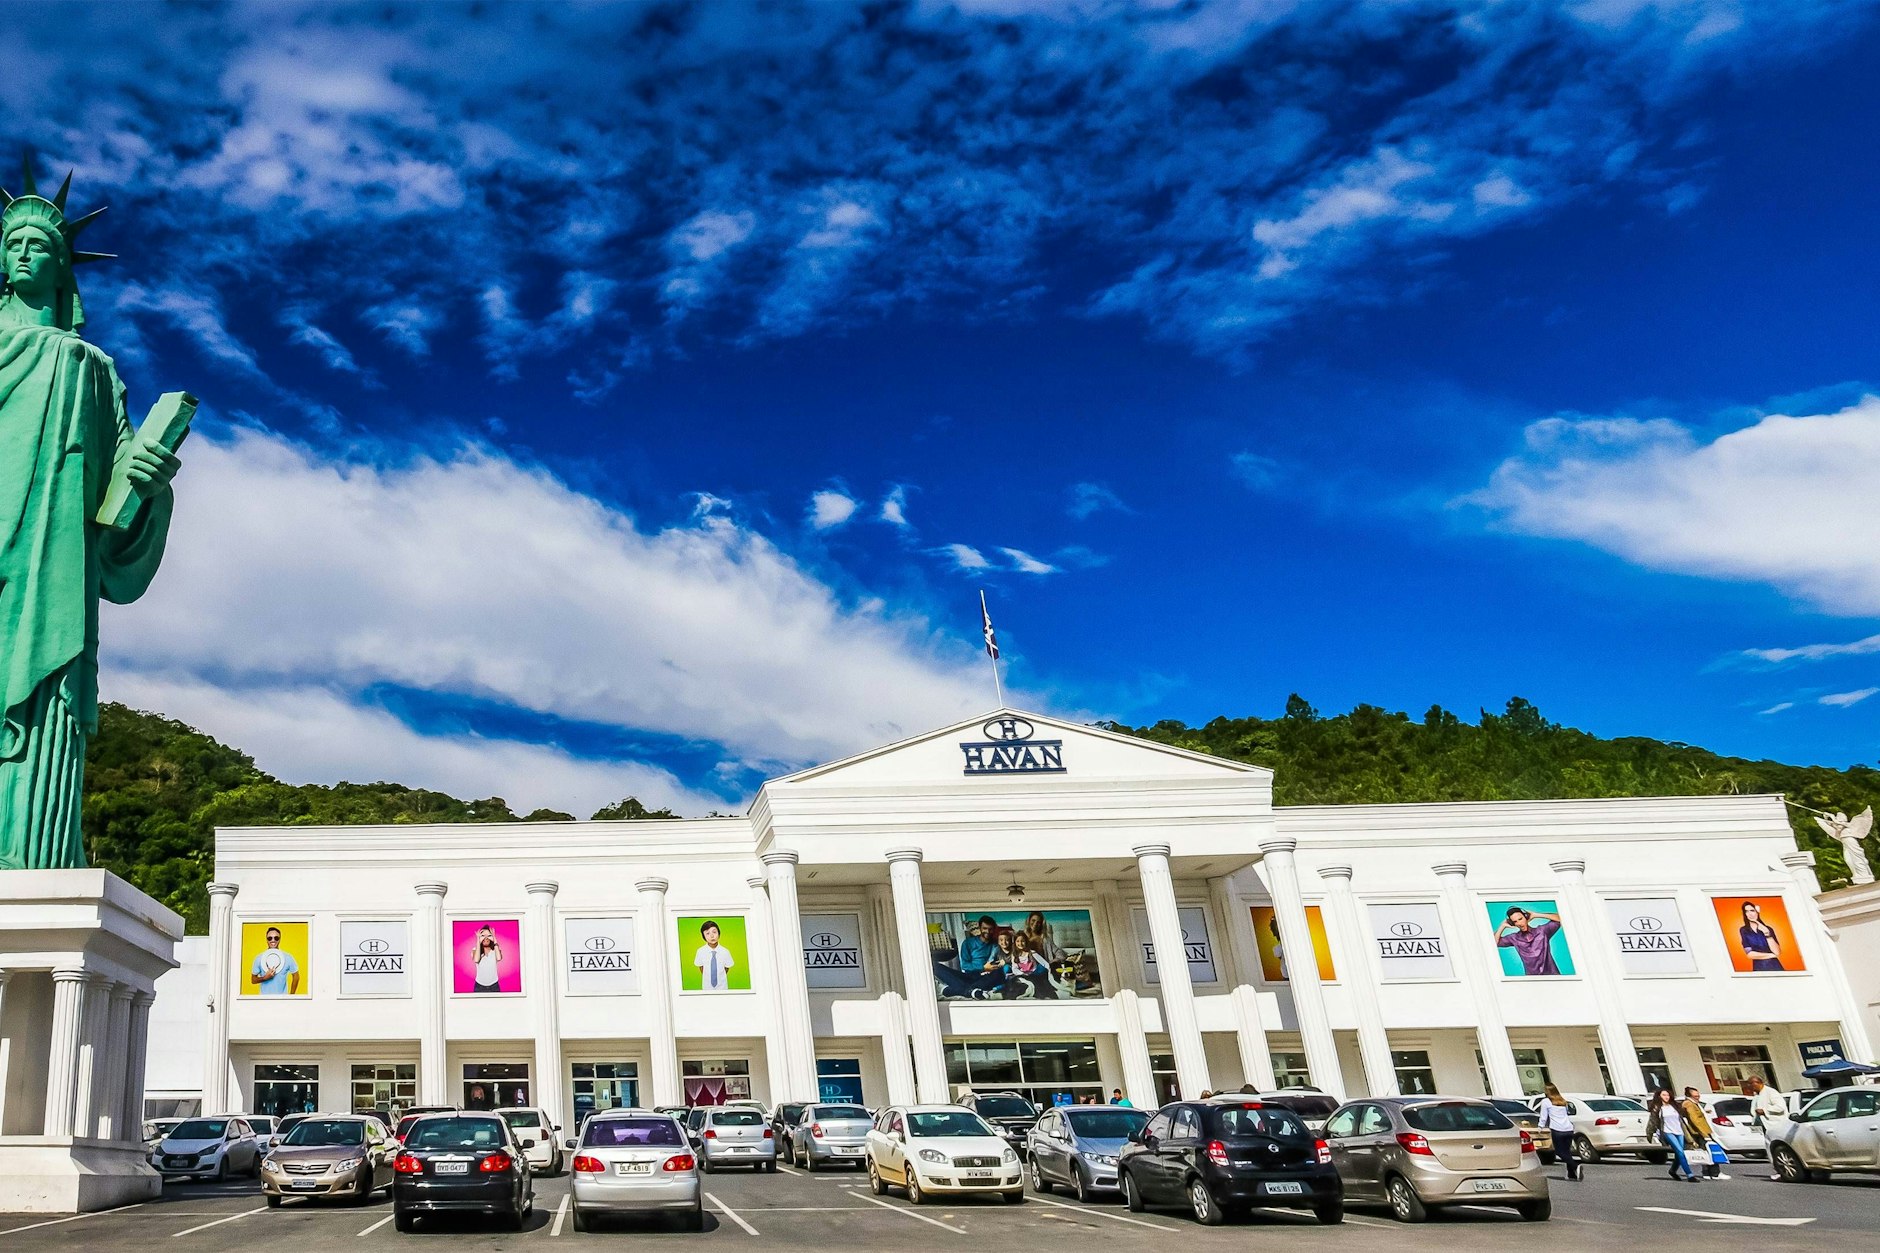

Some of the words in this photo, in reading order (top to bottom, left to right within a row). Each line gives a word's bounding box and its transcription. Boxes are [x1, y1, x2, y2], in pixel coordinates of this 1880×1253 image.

[998, 720, 1018, 738] H
[961, 746, 1063, 769] HAVAN
[1401, 925, 1412, 935] H
[1639, 919, 1652, 930] H
[369, 941, 379, 951] H
[595, 939, 605, 949] H
[821, 935, 832, 946] H
[1619, 935, 1682, 949] HAVAN
[1379, 941, 1441, 955] HAVAN
[345, 957, 403, 970] HAVAN
[571, 955, 630, 968] HAVAN
